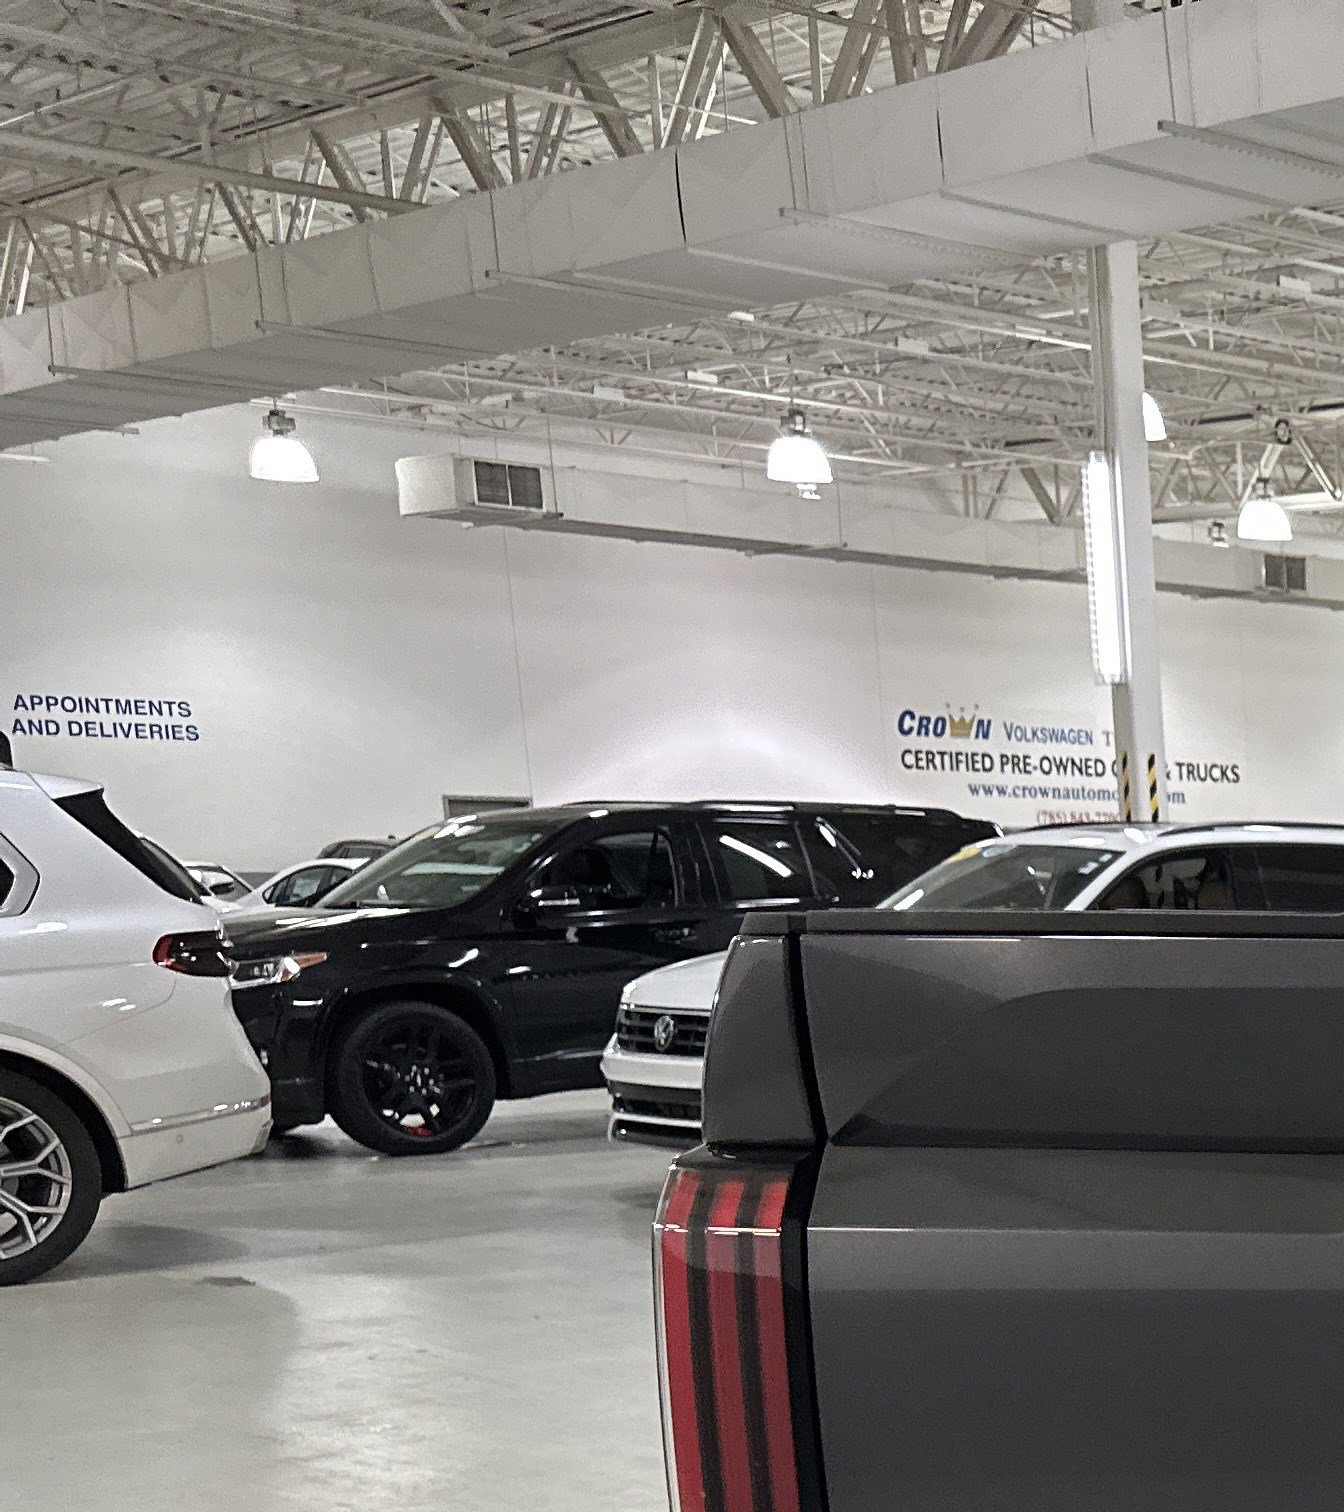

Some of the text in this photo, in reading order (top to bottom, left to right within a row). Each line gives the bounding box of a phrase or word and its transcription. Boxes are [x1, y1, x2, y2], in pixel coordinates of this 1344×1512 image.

[13, 694, 192, 718] APPOINTMENTS
[11, 718, 200, 742] AND DELIVERIES
[1003, 721, 1094, 746] VOLKSWAGEN
[901, 749, 994, 773] CERTIFIED
[1000, 753, 1106, 778] PRE-OWNED
[1175, 761, 1240, 784] TRUCKS
